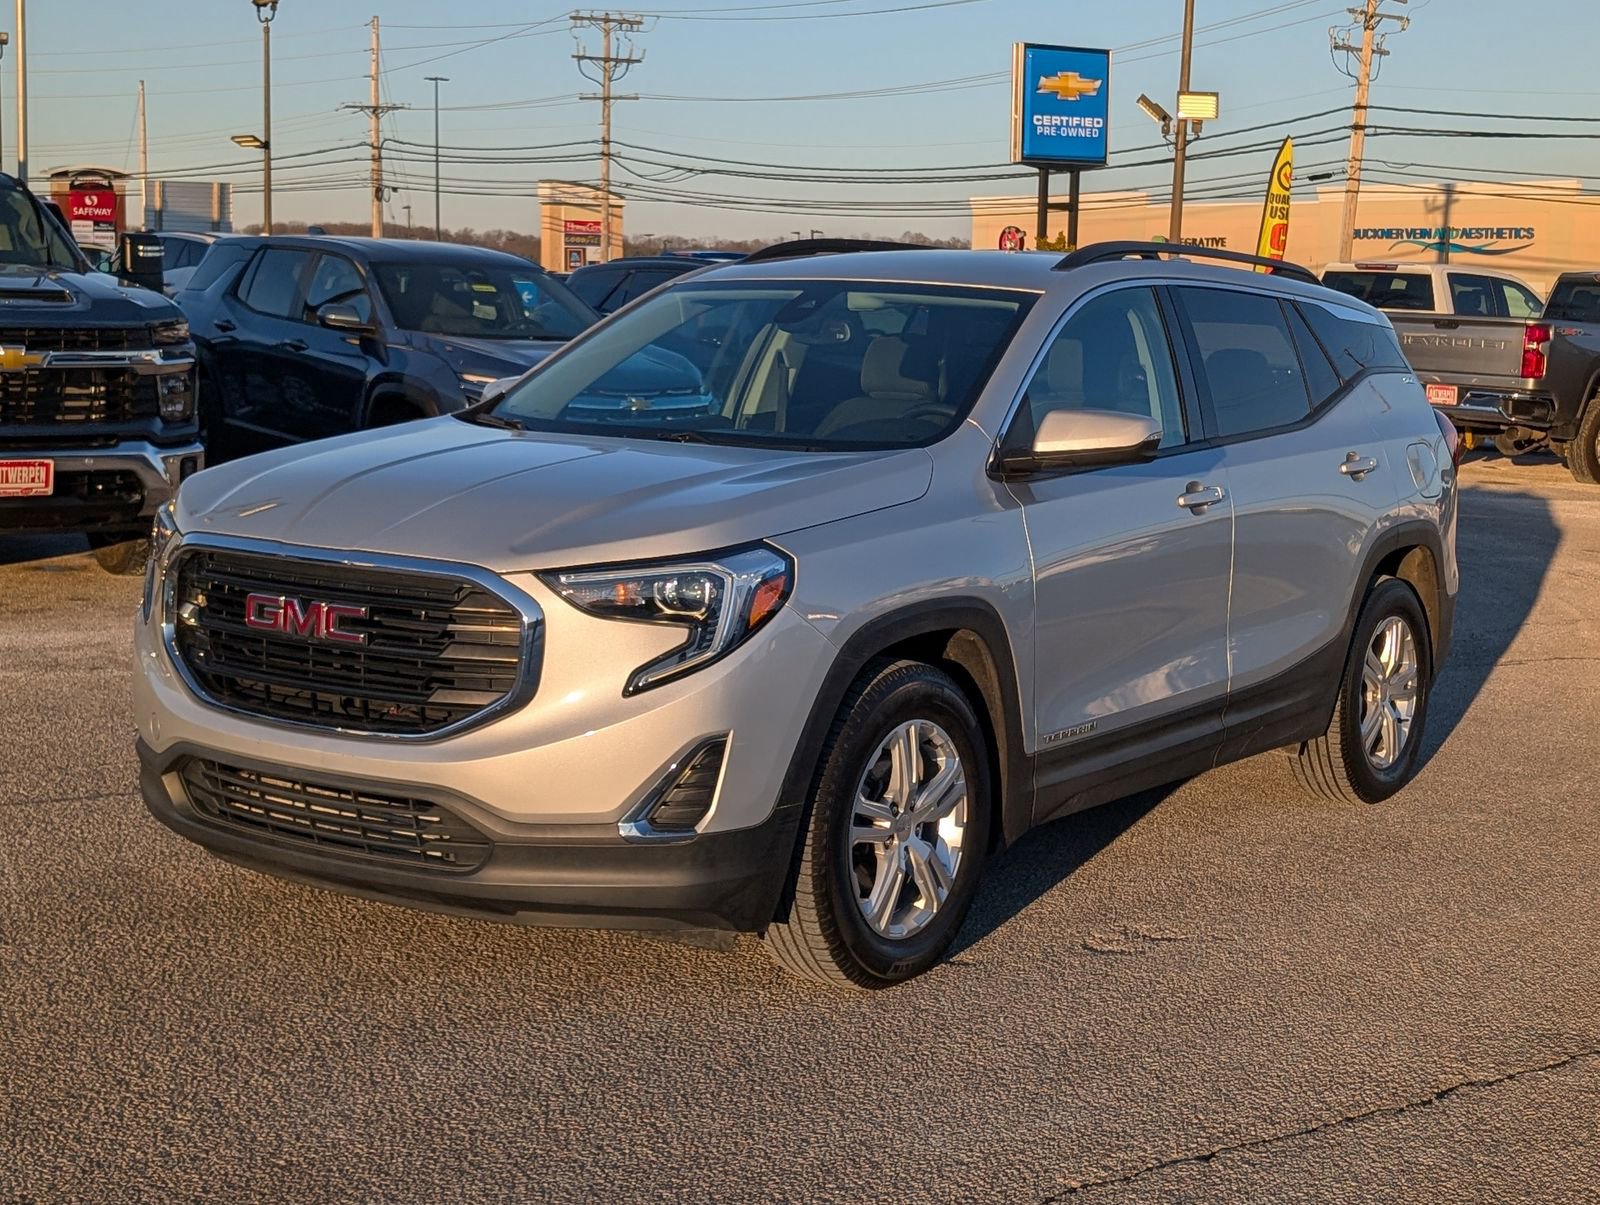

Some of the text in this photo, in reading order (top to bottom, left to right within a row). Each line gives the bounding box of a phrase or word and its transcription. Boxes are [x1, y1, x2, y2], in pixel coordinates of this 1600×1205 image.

[1032, 114, 1104, 128] CERTIFIED
[1036, 126, 1100, 138] PRE-OWNED
[73, 207, 112, 216] SAFEWAY
[1405, 228, 1433, 240] VEIN
[1460, 227, 1535, 240] AESTHETICS
[1180, 237, 1227, 247] EGRATIVE
[1403, 334, 1513, 351] HEVROLET
[245, 592, 369, 644] GMC
